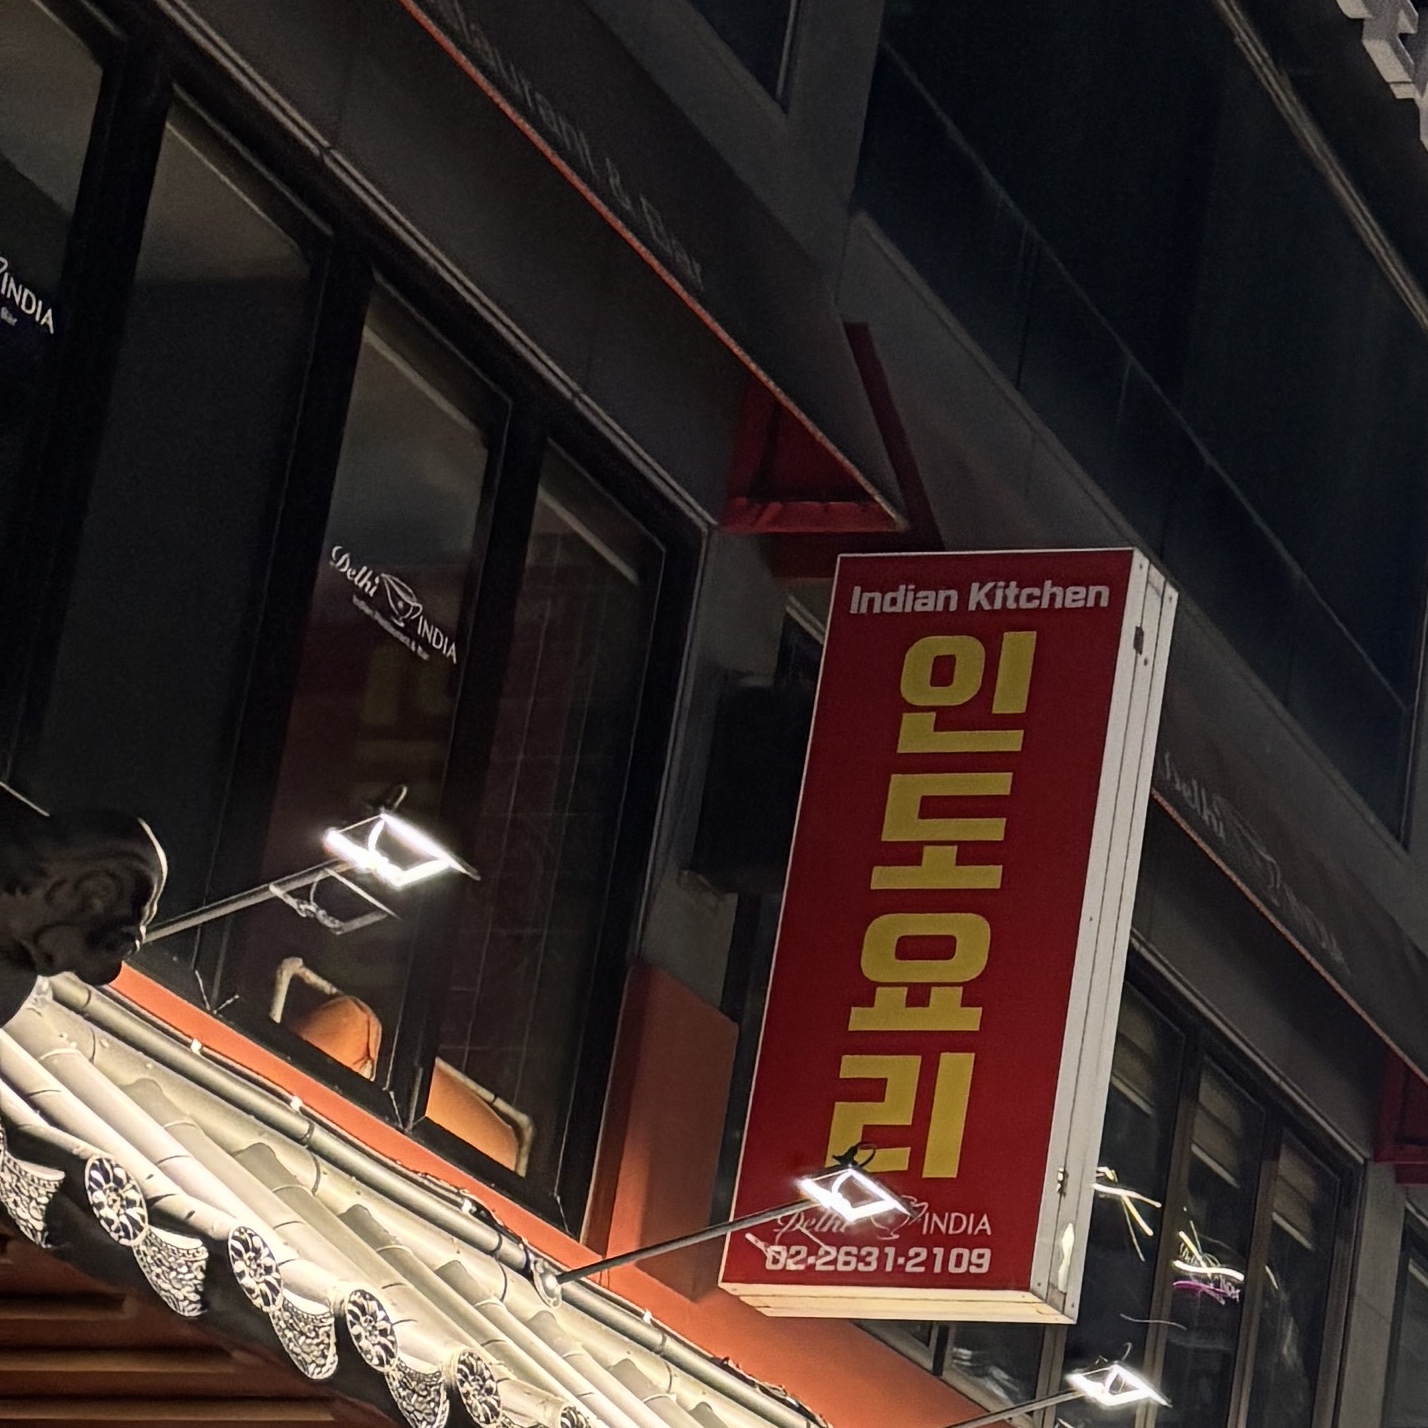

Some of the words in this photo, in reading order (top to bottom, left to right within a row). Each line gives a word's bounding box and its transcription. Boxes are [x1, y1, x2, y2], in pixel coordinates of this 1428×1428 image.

[1, 272, 55, 335] INDIA
[329, 545, 380, 598] Delhi
[417, 615, 458, 665] INDIA
[849, 585, 958, 614] Indian
[967, 579, 1111, 611] Kitchen
[823, 629, 1037, 1179] 인도요리
[921, 1211, 993, 1237] INDIA
